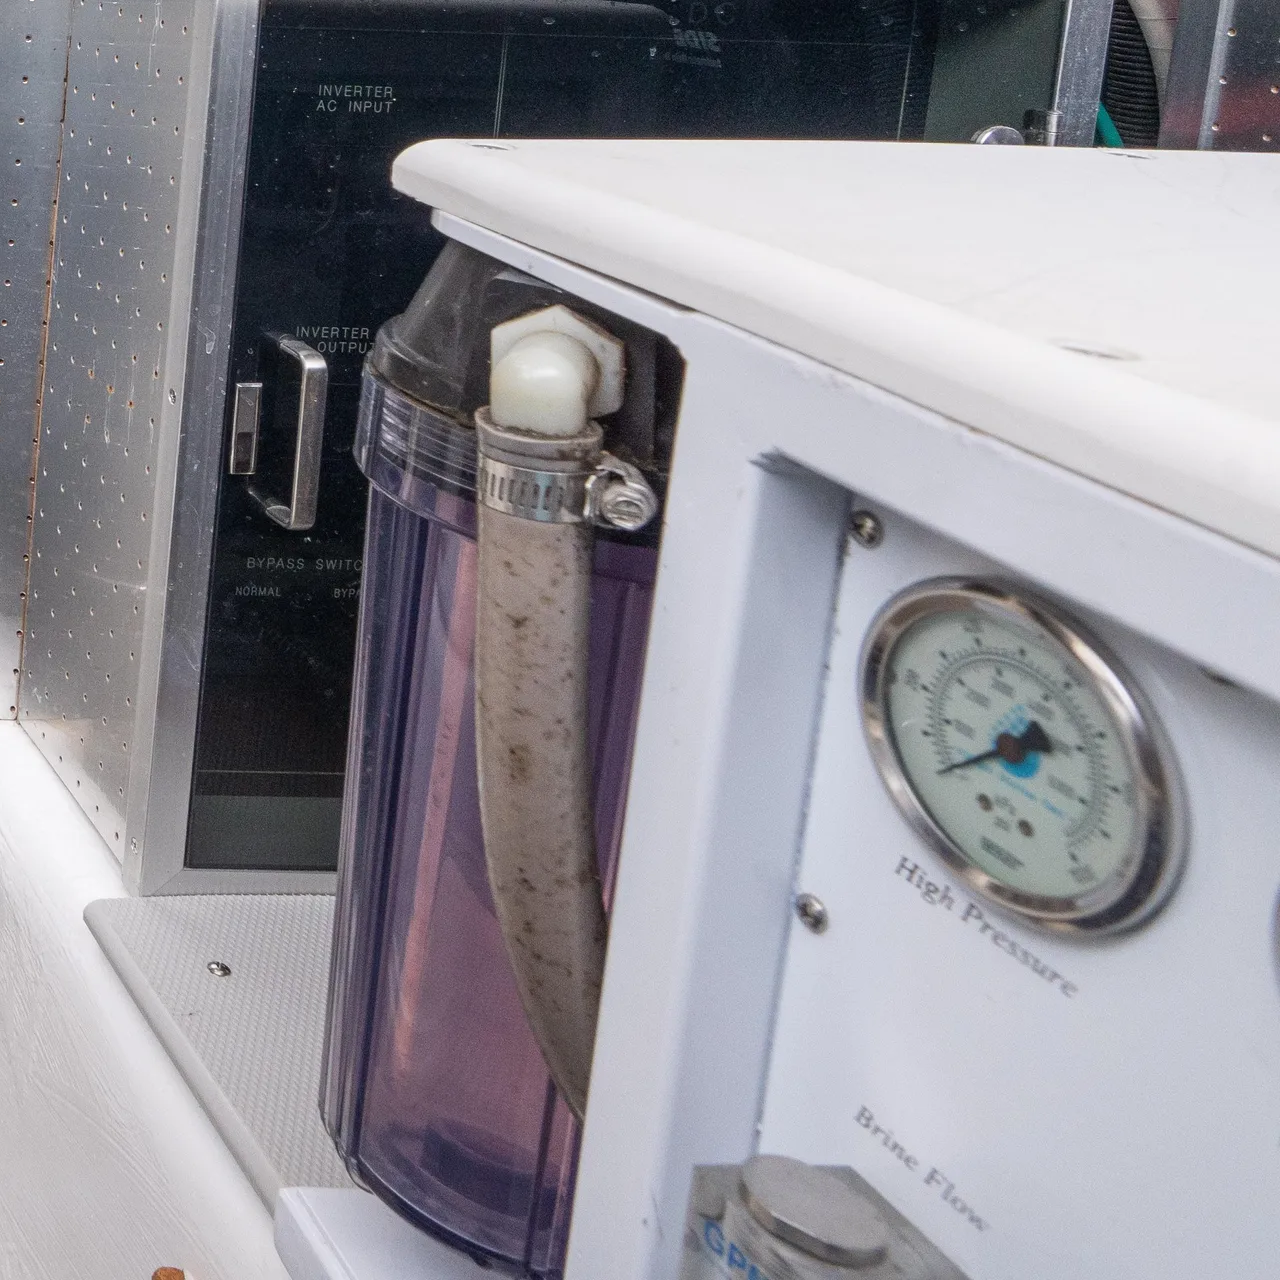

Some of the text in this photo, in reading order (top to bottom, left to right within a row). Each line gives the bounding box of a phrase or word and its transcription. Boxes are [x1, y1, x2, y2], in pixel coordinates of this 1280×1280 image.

[318, 85, 393, 99] INVERTER
[316, 100, 393, 113] AC INPUT
[296, 326, 370, 339] INVERTER
[246, 557, 363, 572] BYPASS SWITC
[235, 586, 281, 598] NORMAL
[894, 856, 1079, 999] High Pressure
[853, 1104, 991, 1232] Brine Flow
